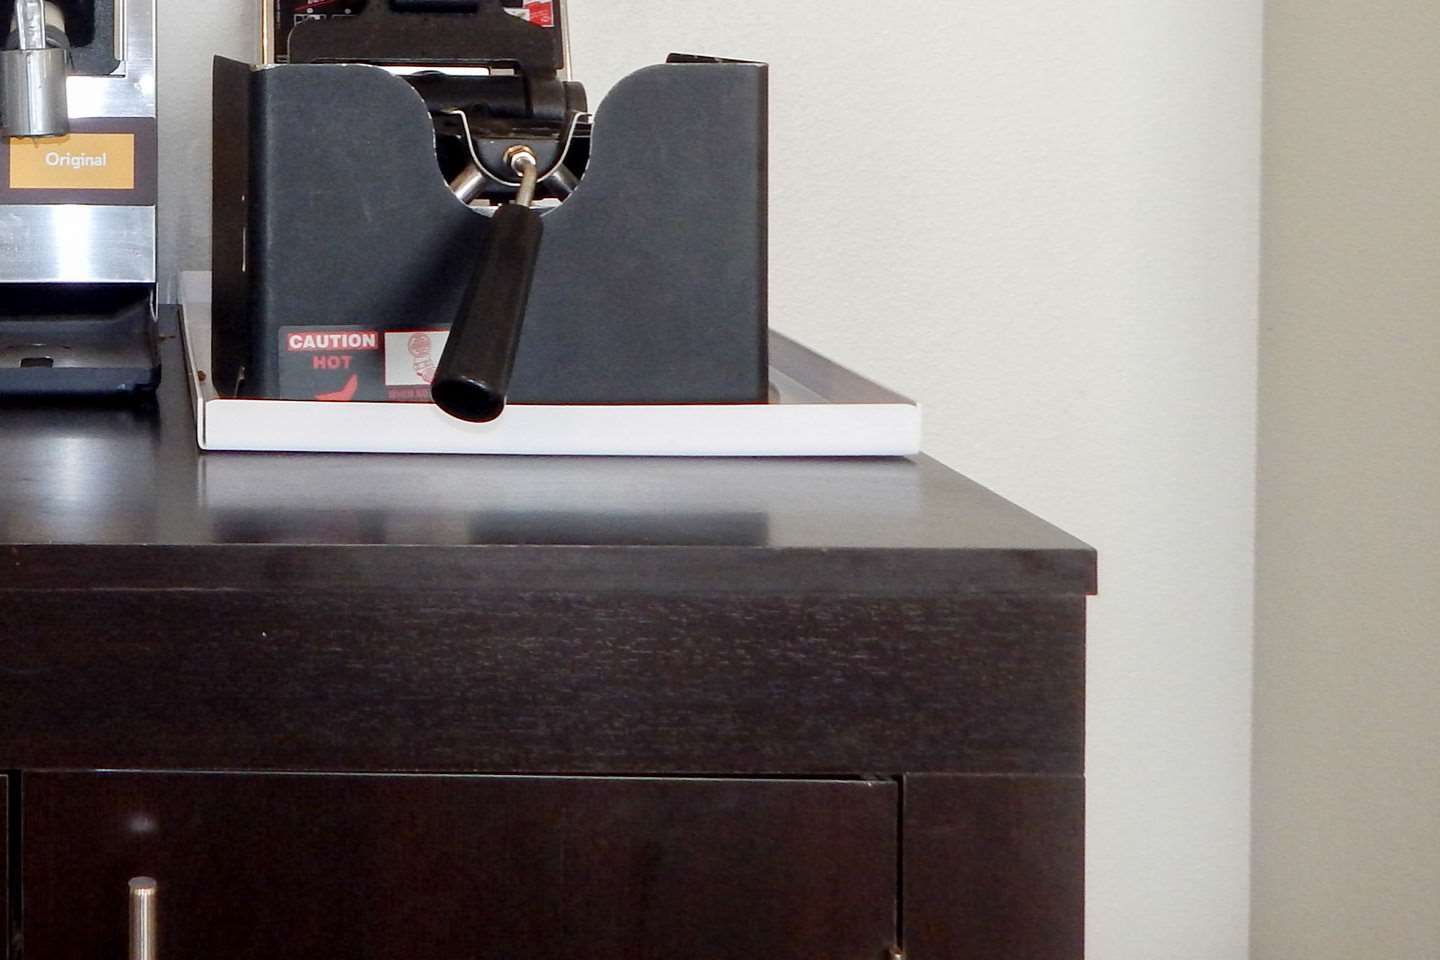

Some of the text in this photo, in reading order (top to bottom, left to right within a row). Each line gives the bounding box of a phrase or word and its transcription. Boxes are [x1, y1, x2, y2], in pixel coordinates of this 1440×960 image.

[45, 151, 107, 169] Original
[288, 332, 376, 349] CAUTION
[312, 355, 352, 369] HOT
